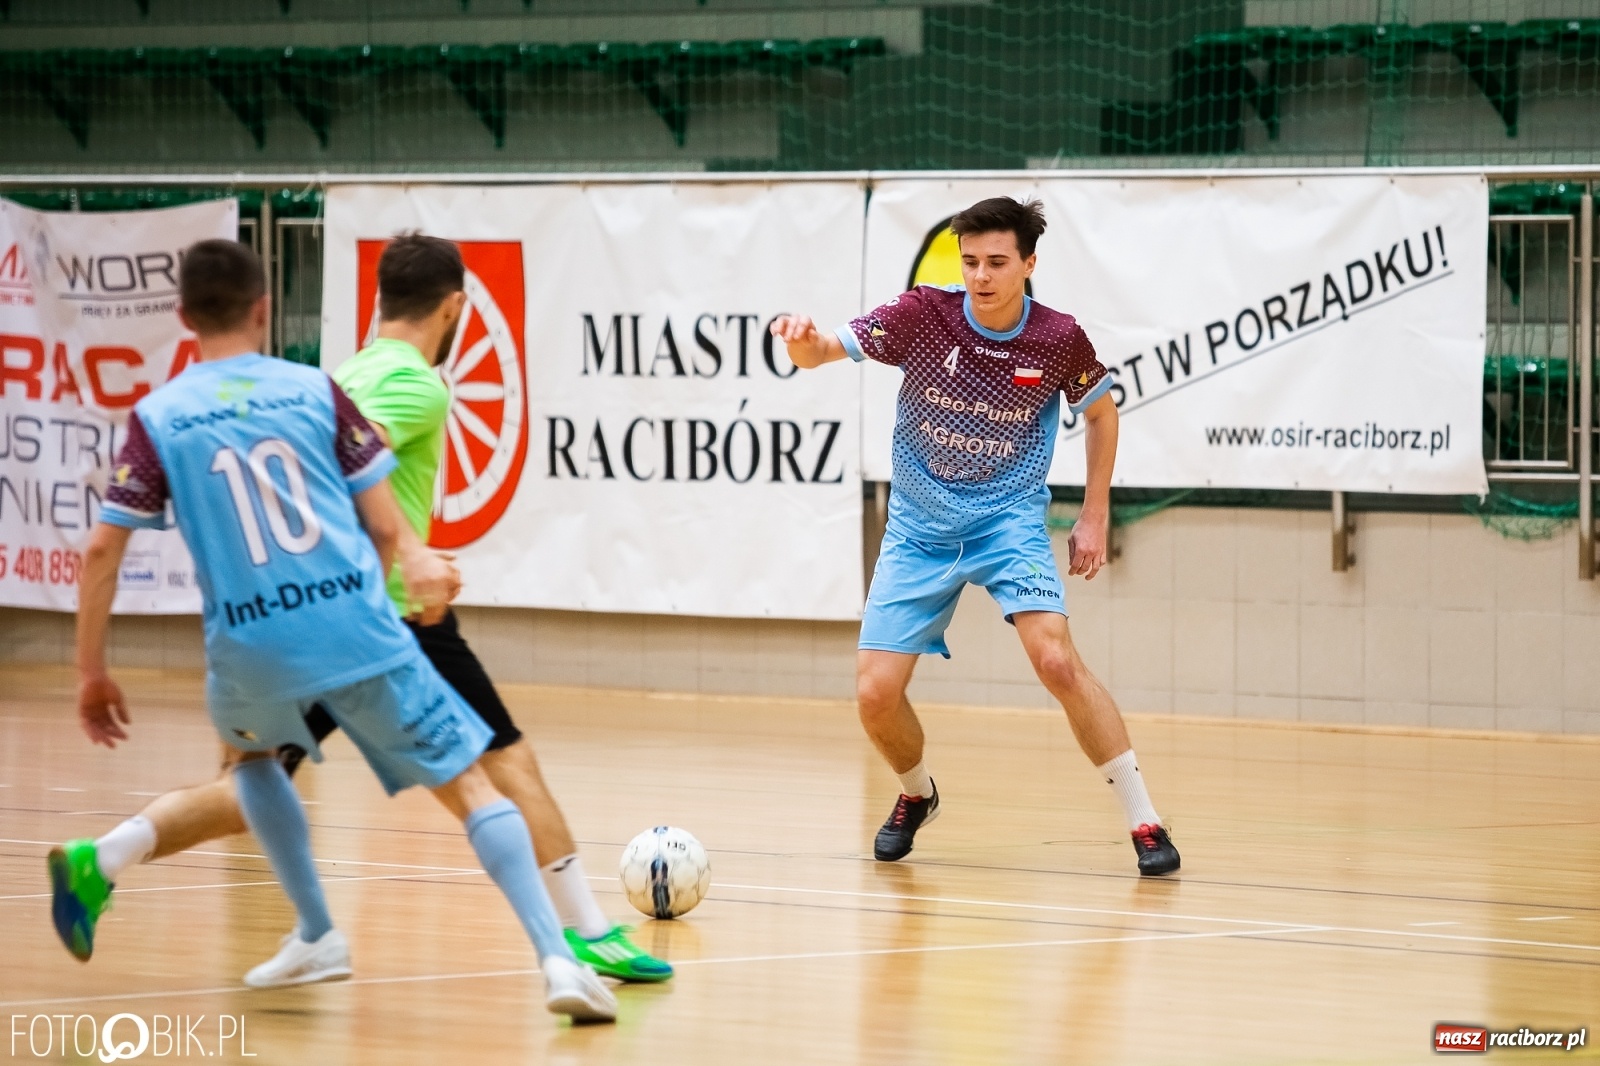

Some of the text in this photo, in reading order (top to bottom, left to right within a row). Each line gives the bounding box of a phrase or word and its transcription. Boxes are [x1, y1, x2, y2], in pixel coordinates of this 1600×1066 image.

[56, 250, 183, 291] WOR
[1155, 333, 1193, 384] W
[1205, 225, 1450, 365] PORZĄDKU!
[580, 313, 800, 379] MIASTO
[943, 345, 960, 377] 4
[925, 386, 1032, 422] Geo-Punkt
[545, 398, 845, 484] RACIBÓRZ
[1205, 420, 1451, 457] www.osir-raciborz.pl
[208, 437, 324, 569] 10
[224, 570, 364, 627] Int-Drew
